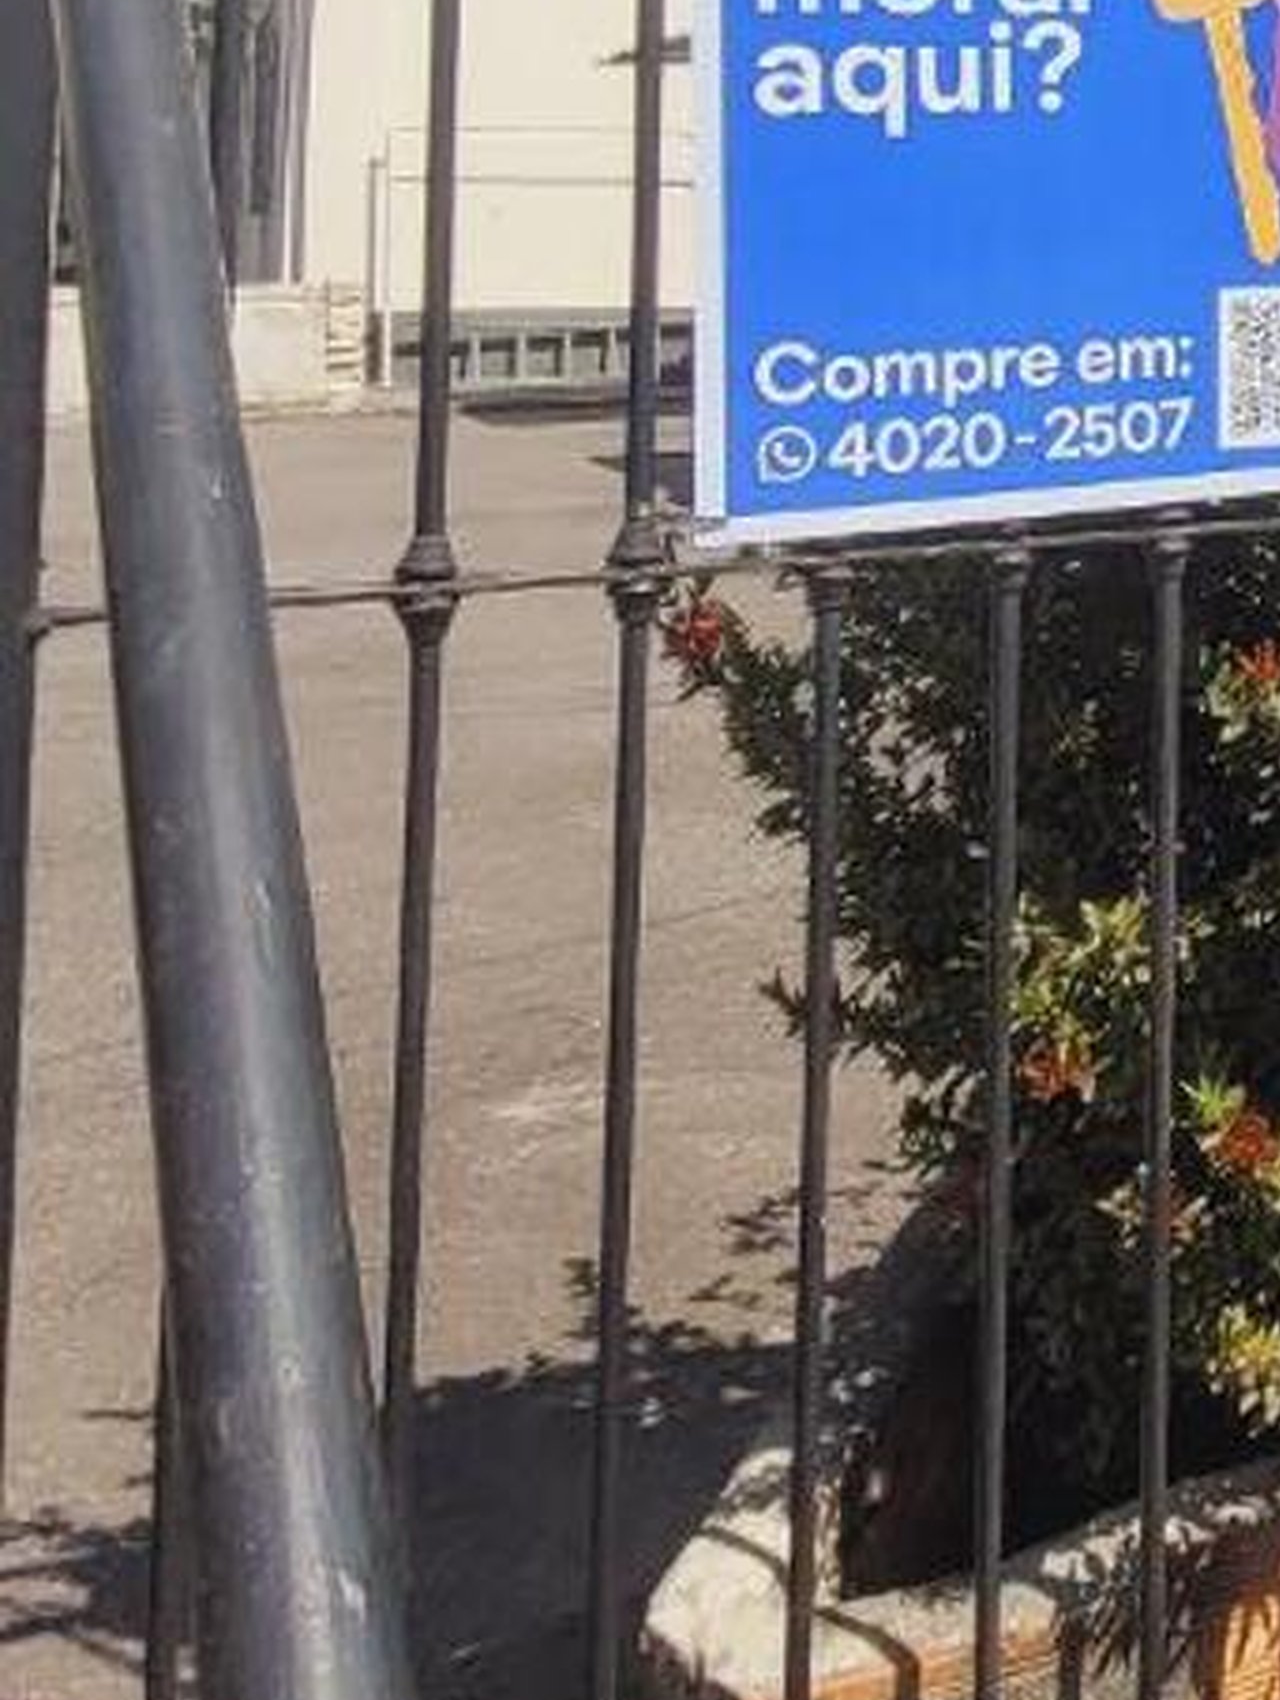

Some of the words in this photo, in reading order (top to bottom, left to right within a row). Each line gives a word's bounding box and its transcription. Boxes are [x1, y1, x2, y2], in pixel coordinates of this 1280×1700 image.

[754, 20, 1082, 139] aqui?
[754, 341, 1060, 407] Compre
[1078, 335, 1193, 383] em:
